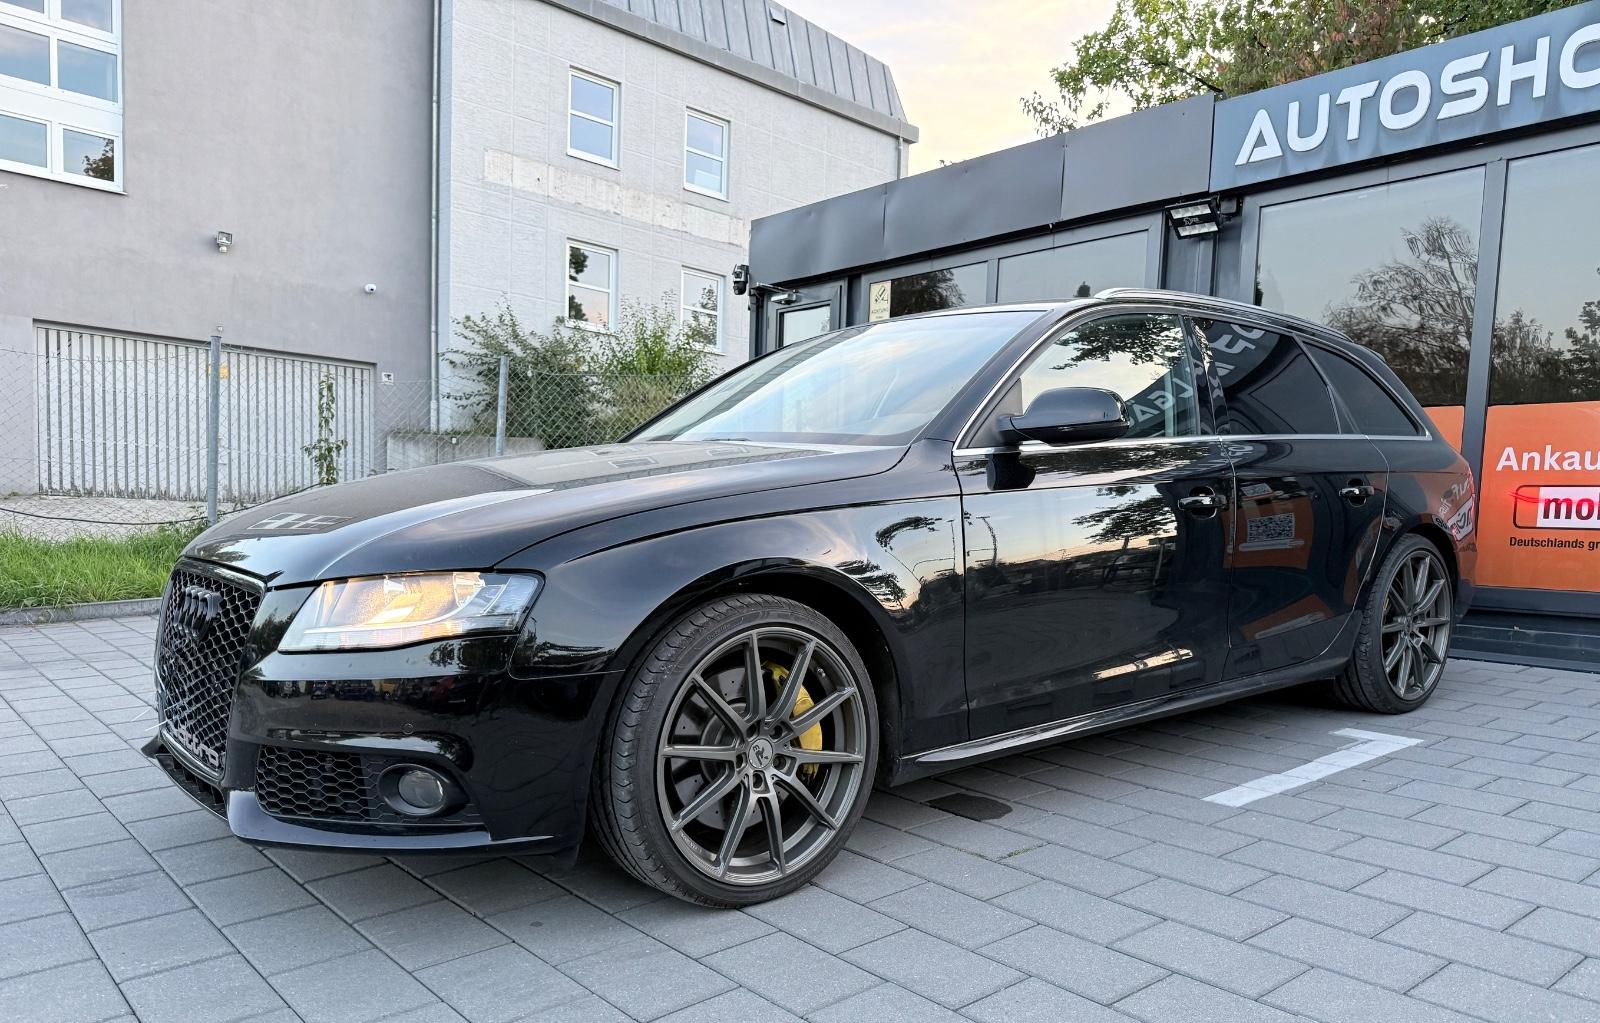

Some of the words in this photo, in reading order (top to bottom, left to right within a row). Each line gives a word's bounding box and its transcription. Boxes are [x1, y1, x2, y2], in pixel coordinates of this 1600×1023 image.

[1235, 22, 1600, 166] AUTOSHO
[1495, 444, 1600, 472] Ankau
[1543, 492, 1600, 520] mo
[1509, 536, 1585, 549] Deutschlands
